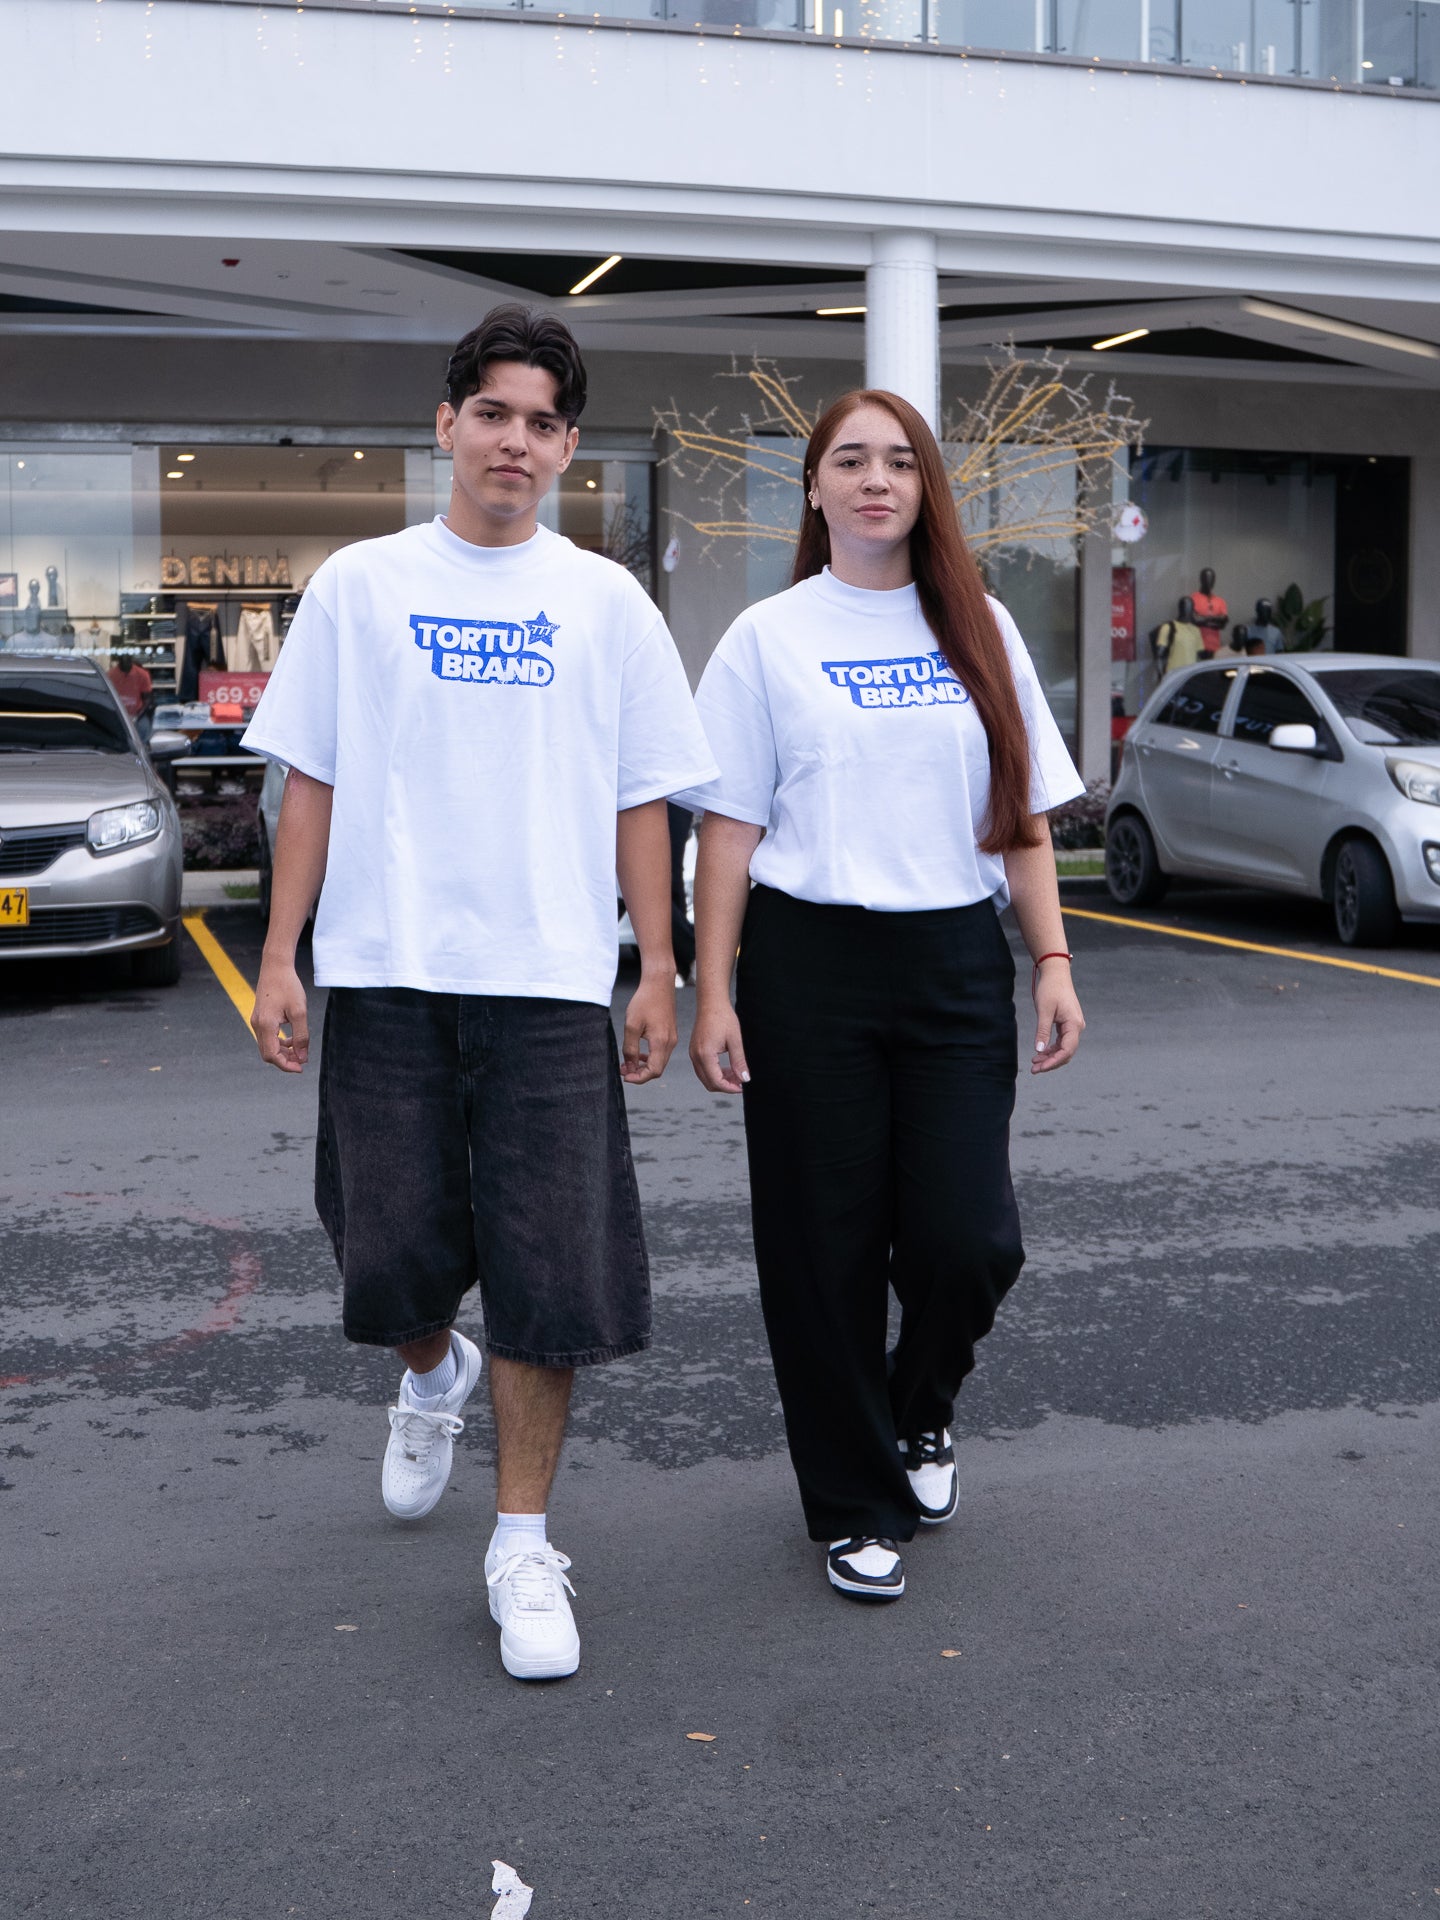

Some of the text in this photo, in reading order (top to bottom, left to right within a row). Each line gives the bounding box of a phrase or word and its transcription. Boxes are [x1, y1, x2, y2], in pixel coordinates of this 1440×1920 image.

[161, 556, 289, 585] DENIM
[417, 622, 522, 653] TORTU
[441, 652, 552, 683] BRAND
[829, 661, 931, 685] TORTU
[859, 682, 968, 706] BRAND
[1, 893, 25, 915] 47
